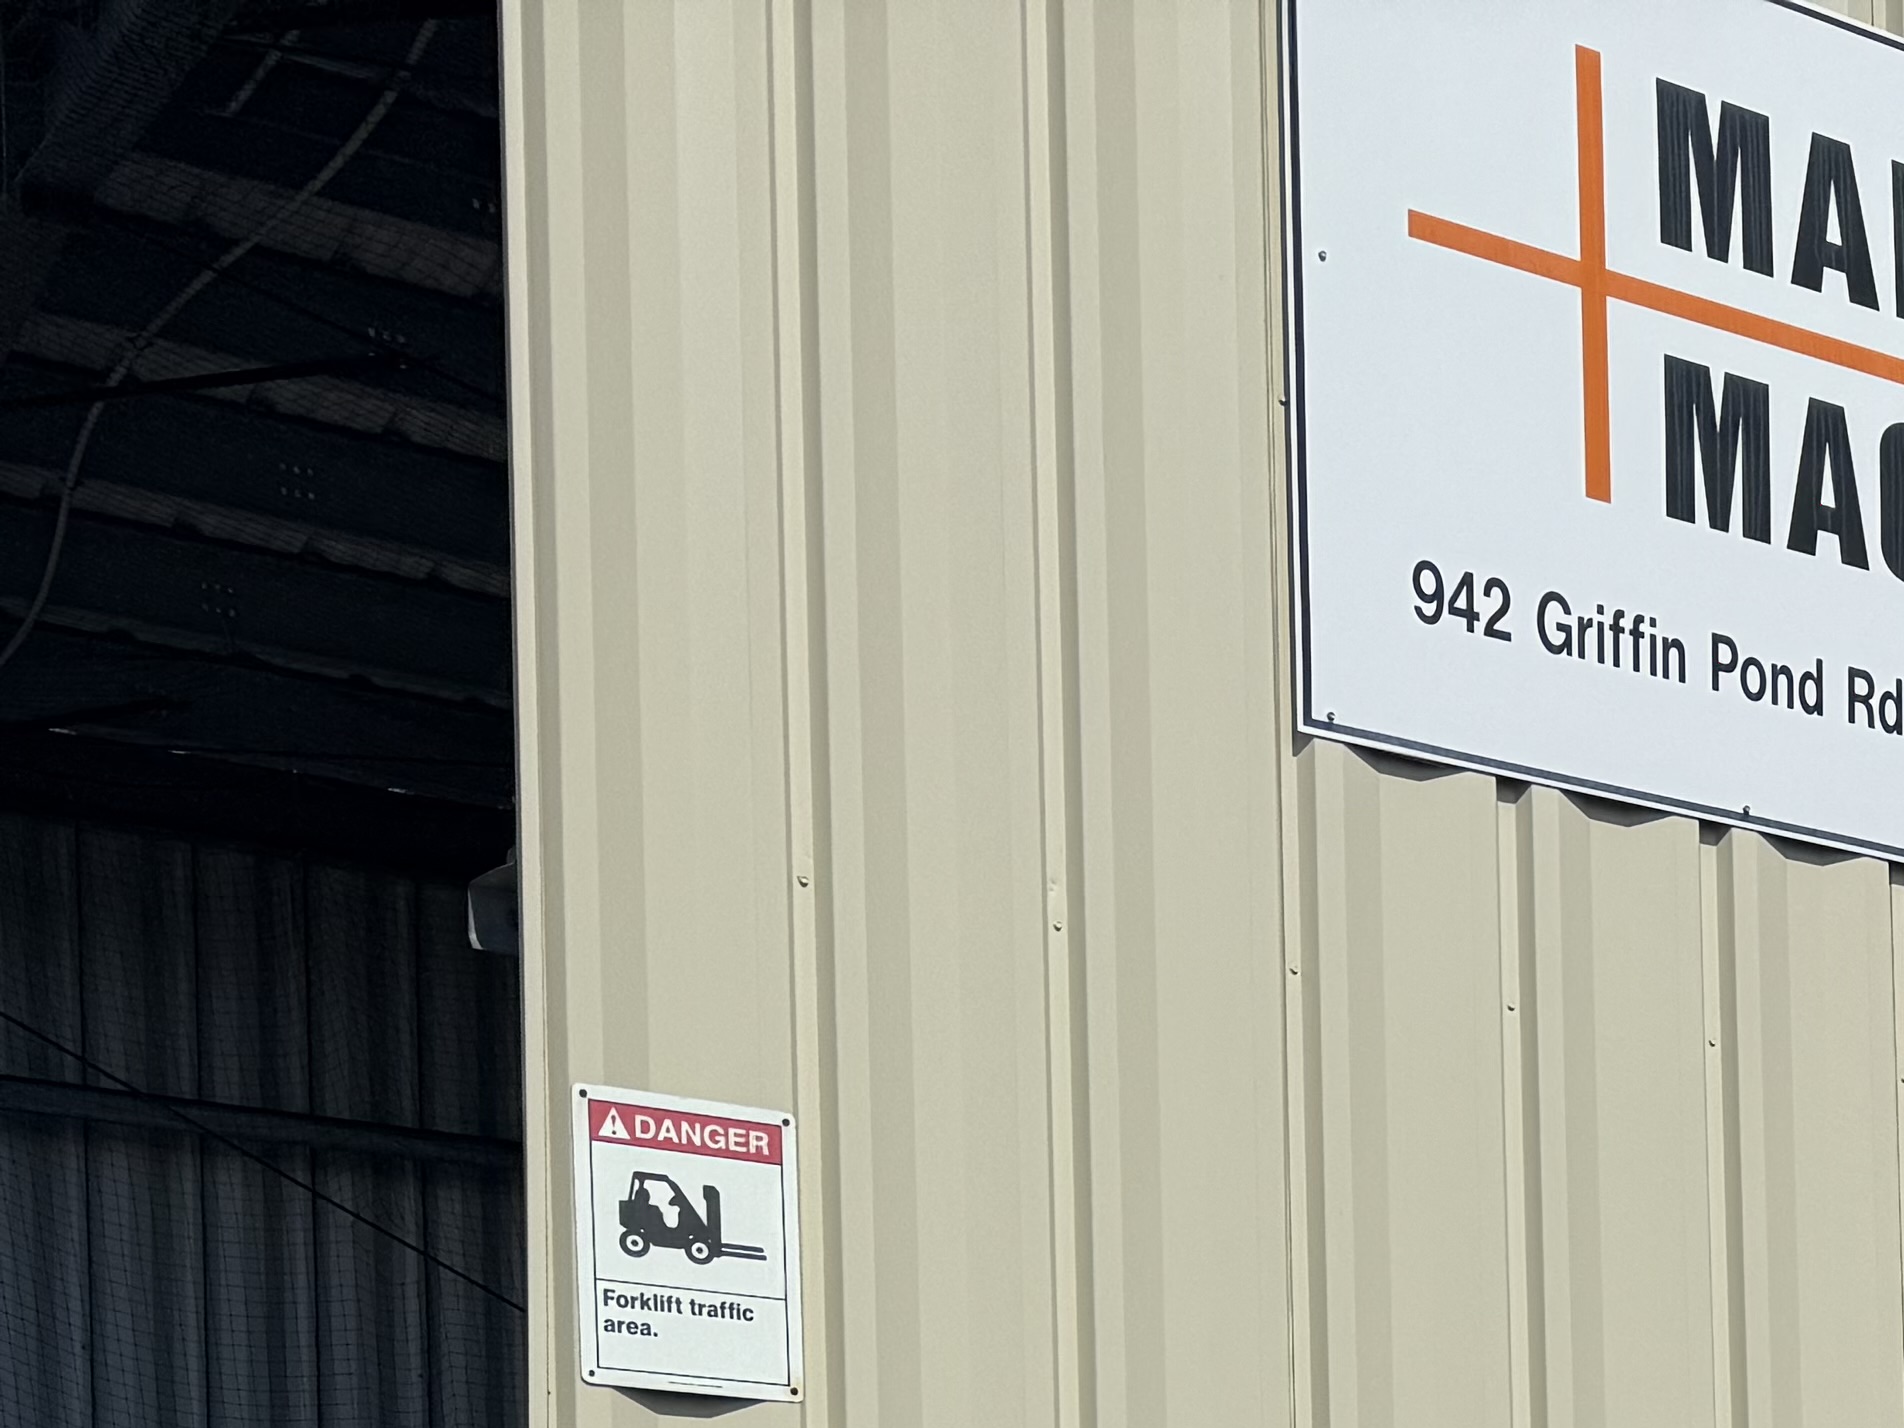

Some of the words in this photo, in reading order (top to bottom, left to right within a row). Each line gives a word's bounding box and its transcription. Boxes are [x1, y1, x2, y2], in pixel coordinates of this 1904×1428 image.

[1411, 559, 1513, 643] 942
[1536, 590, 1687, 684] Griffin
[1710, 631, 1824, 717] Pond
[634, 1114, 771, 1156] DANGER
[602, 1287, 684, 1315] Forklift
[688, 1297, 755, 1322] traffic
[603, 1317, 659, 1338] area.
